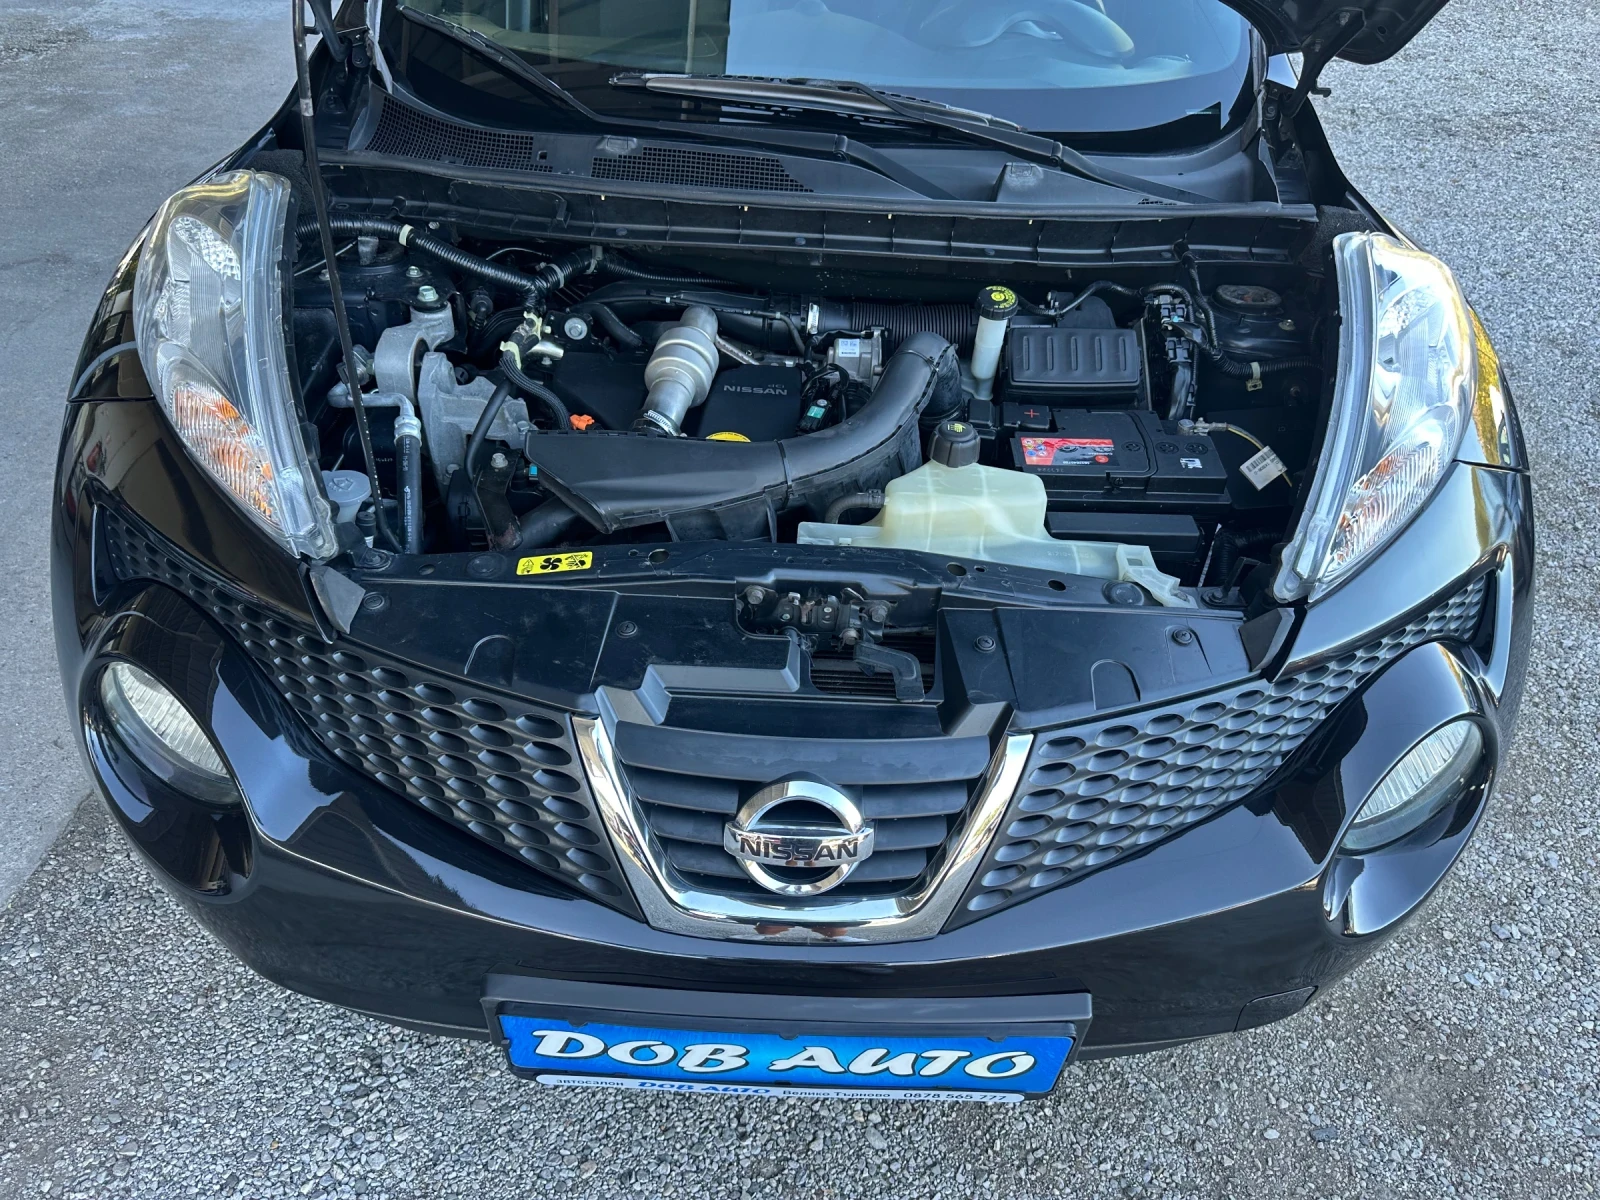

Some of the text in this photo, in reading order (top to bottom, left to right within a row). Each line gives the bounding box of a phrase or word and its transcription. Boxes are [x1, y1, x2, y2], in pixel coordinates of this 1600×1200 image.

[723, 384, 788, 396] NISSAN
[739, 837, 859, 861] NISSAN
[532, 1029, 1037, 1078] DOB AUTO
[556, 1079, 624, 1087] автосалон
[637, 1081, 695, 1091] DOB
[700, 1086, 771, 1094] AUTO
[835, 1091, 891, 1099] Търново
